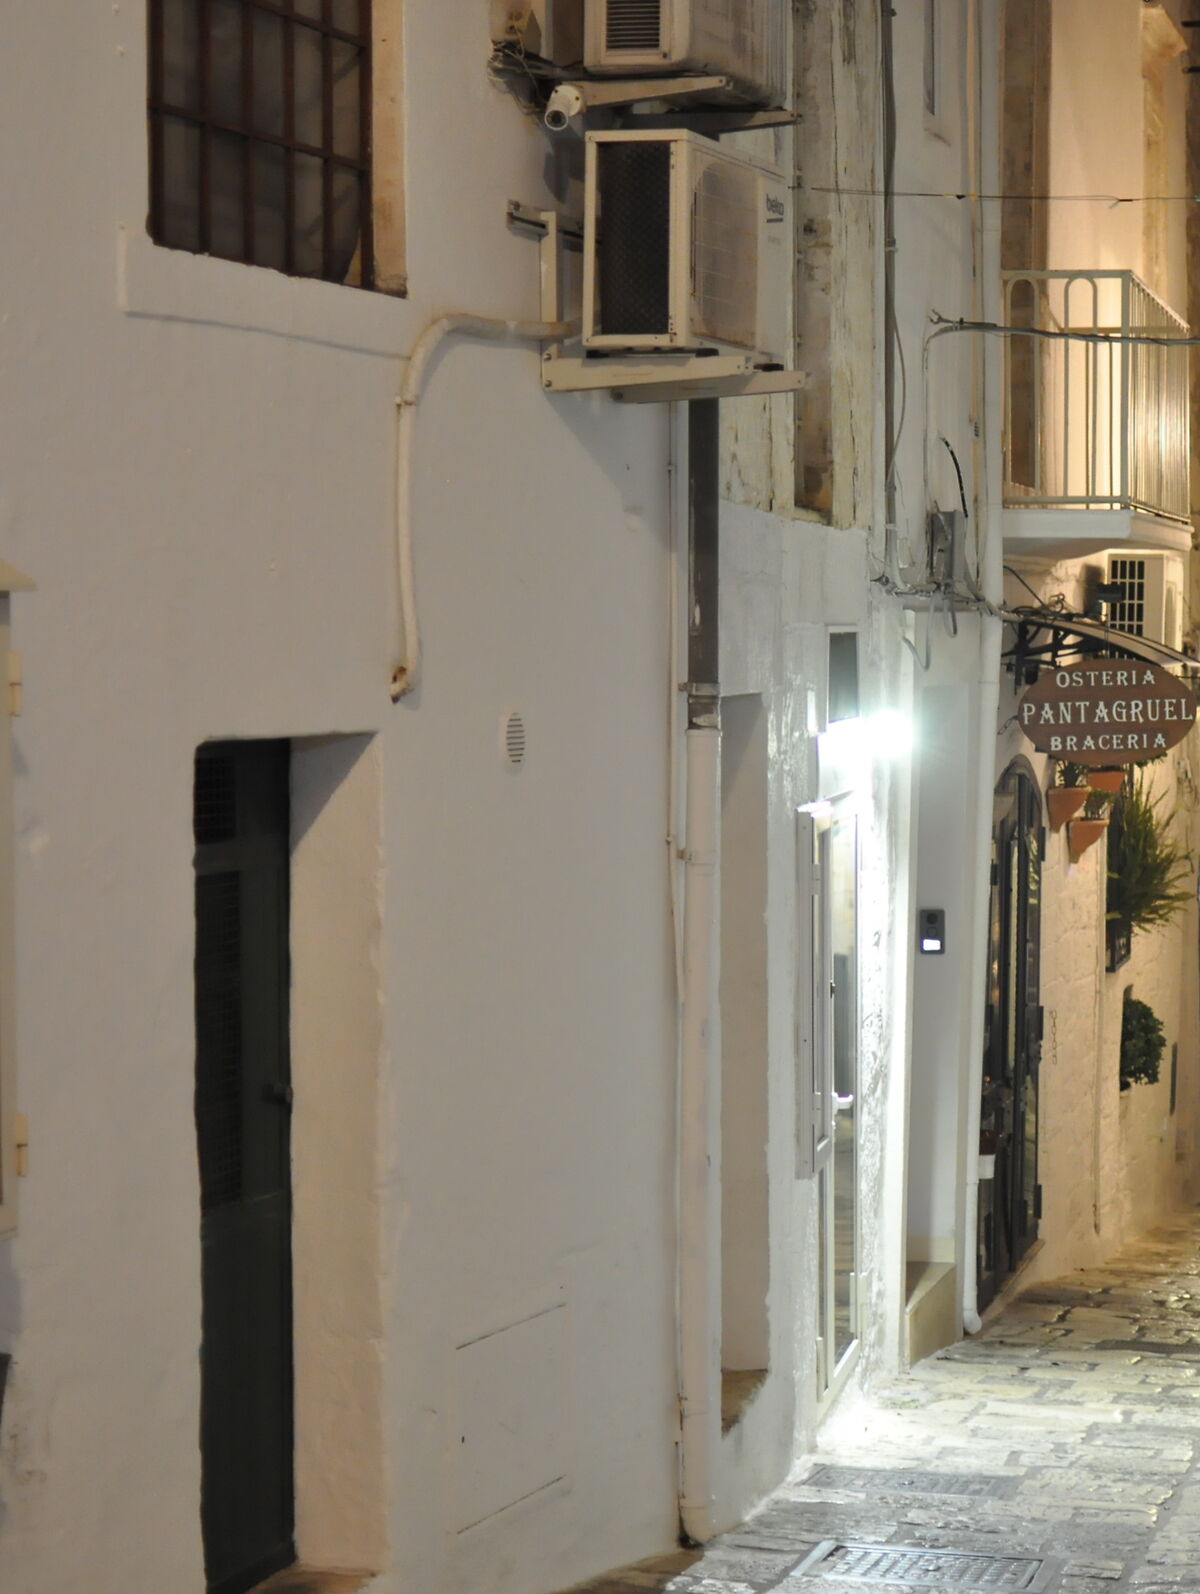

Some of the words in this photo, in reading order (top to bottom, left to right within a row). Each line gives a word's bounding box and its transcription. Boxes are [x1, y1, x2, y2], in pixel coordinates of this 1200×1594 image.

[1055, 669, 1156, 688] OSTERIA
[1022, 698, 1194, 726] PANTAGRUEL
[1050, 732, 1167, 752] BRACERIA
